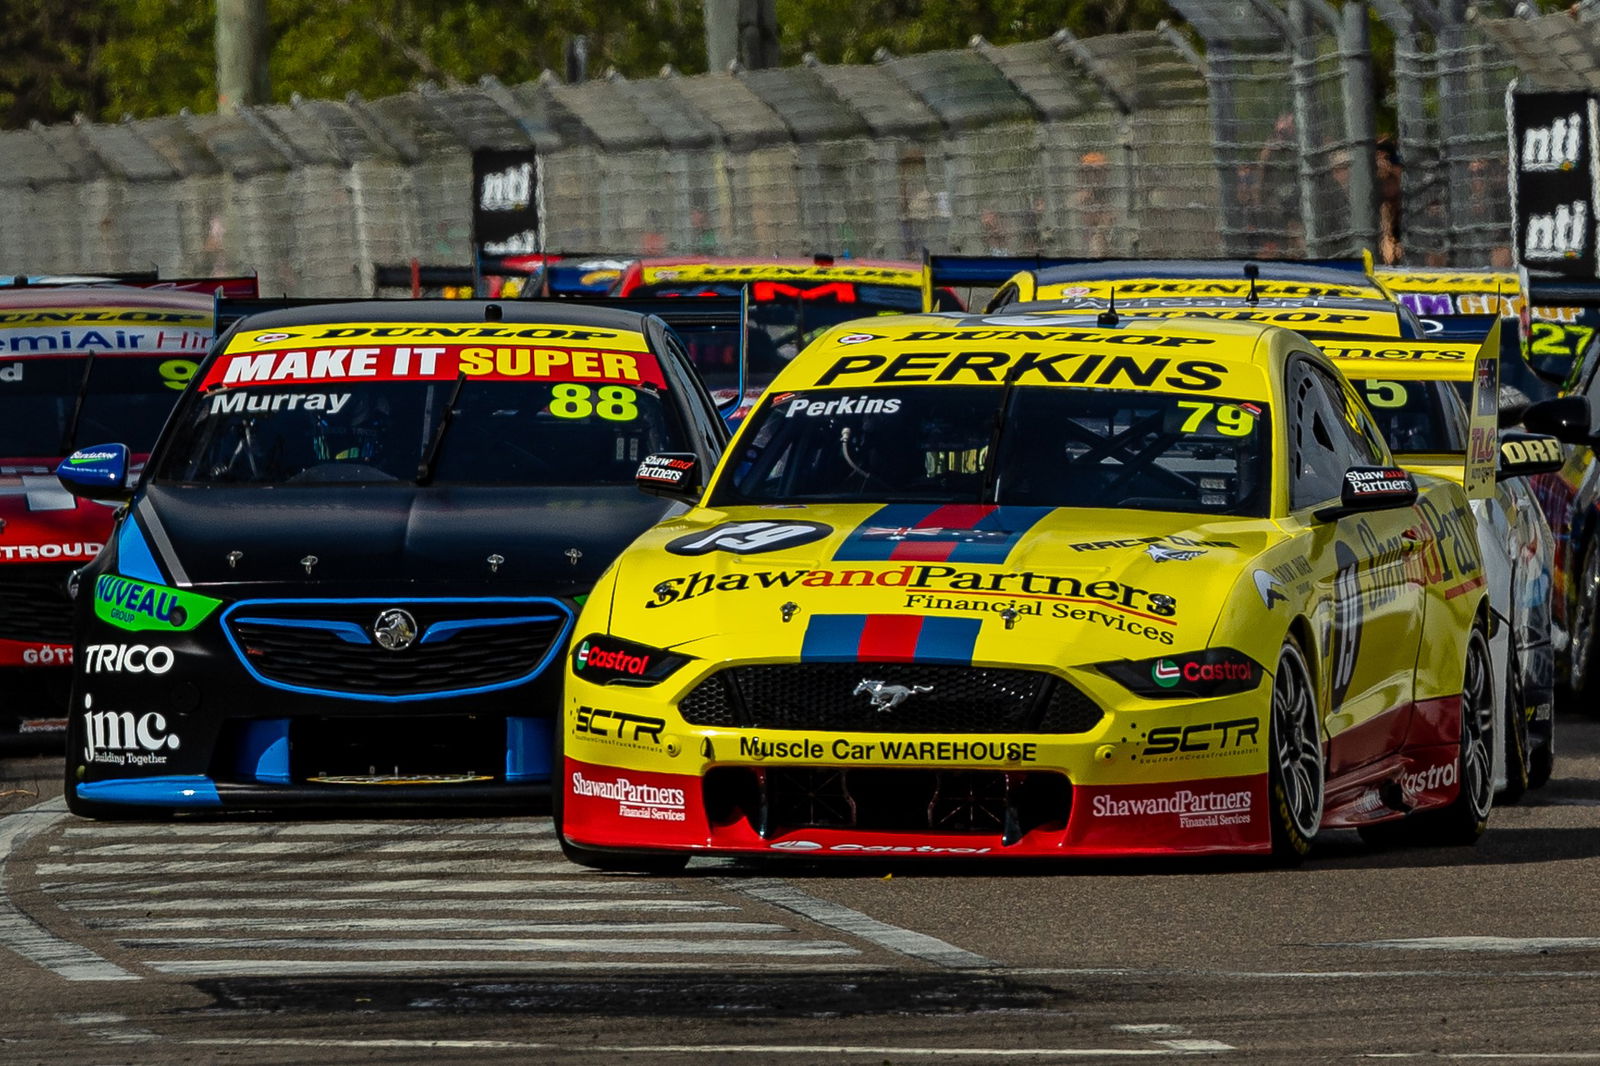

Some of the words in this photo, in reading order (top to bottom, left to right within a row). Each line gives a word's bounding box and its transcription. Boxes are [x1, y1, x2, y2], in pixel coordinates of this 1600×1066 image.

[312, 327, 618, 341] DUNLOP
[893, 329, 1216, 347] DUNLOP
[1531, 323, 1594, 355] 27
[222, 348, 390, 383] MAKE
[392, 347, 447, 377] IT
[458, 347, 640, 382] SUPER
[813, 351, 1228, 391] PERKINS
[210, 391, 351, 416] Murray
[548, 383, 638, 421] 88
[785, 396, 902, 418] Perkins
[1176, 401, 1253, 438] 79
[1350, 479, 1412, 494] Partners
[681, 522, 816, 551] 79
[95, 577, 177, 621] NUVEAU
[111, 608, 135, 624] GROUP
[904, 594, 1042, 616] Financial
[1052, 603, 1174, 645] Services
[85, 644, 174, 674] TRICO
[587, 646, 649, 675] Castrol
[1183, 661, 1251, 682] Castrol
[576, 705, 666, 744] SCTR
[1142, 717, 1259, 756] SCTR
[94, 752, 125, 765] Building
[126, 752, 167, 766] Together
[740, 737, 824, 759] Muscle
[831, 739, 875, 760] Car
[880, 742, 1037, 762] WAREHOUSE
[572, 772, 684, 805] ShawandPartners
[619, 805, 650, 818] Financial
[651, 808, 685, 821] Services
[1092, 789, 1252, 818] ShawandPartners
[1179, 815, 1217, 828] Financial
[1219, 813, 1252, 826] Services
[830, 843, 991, 854] Castrol
